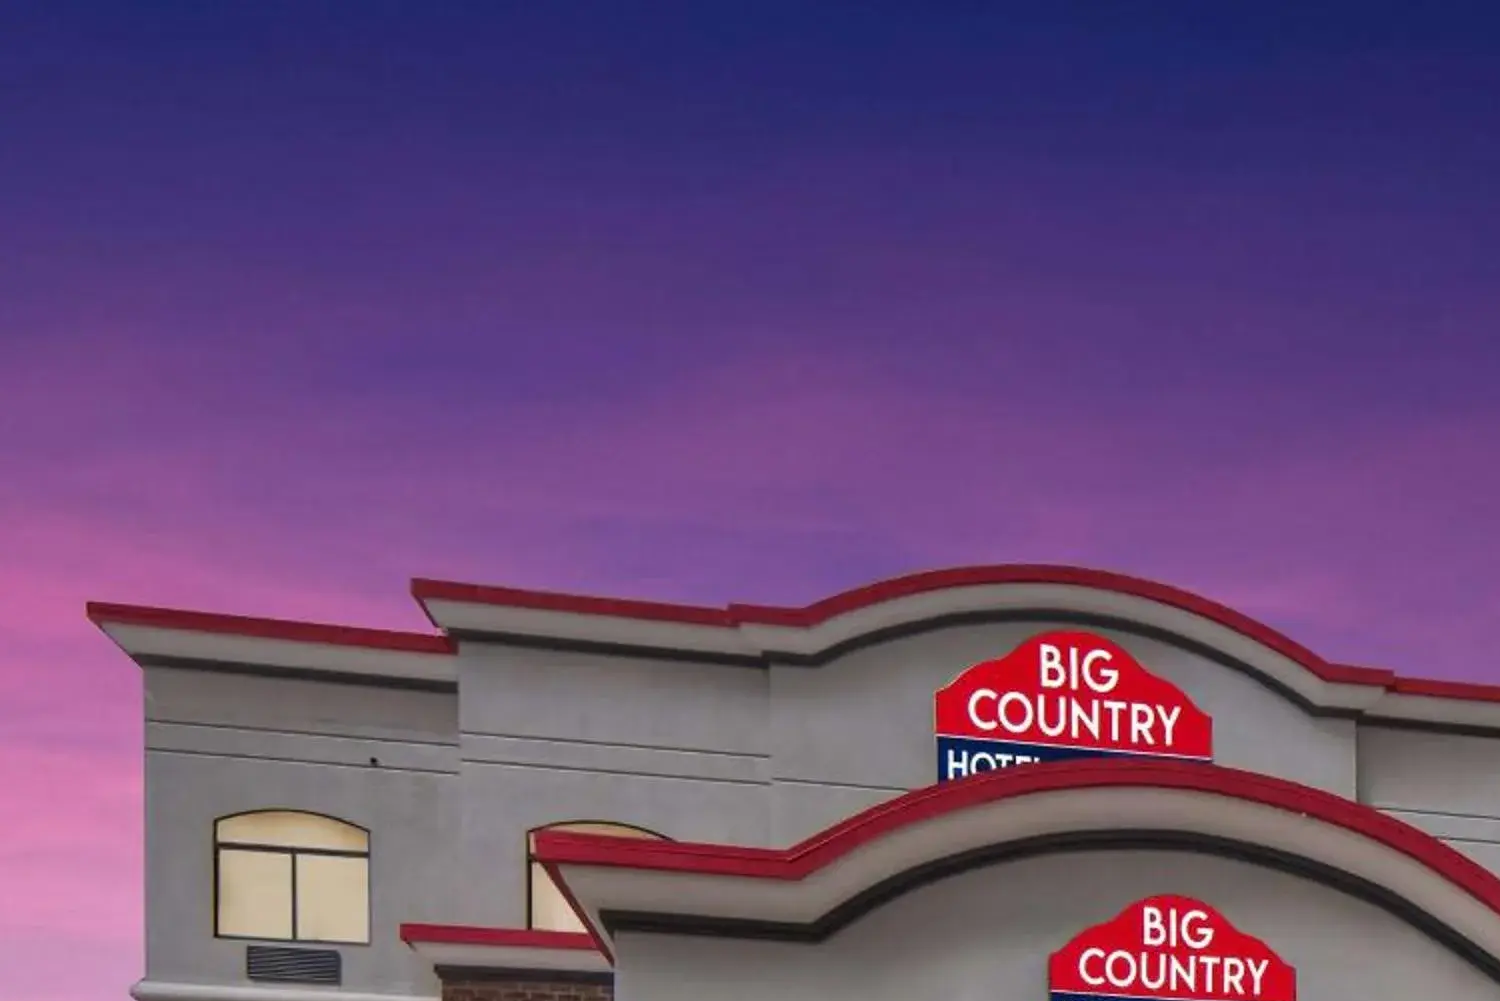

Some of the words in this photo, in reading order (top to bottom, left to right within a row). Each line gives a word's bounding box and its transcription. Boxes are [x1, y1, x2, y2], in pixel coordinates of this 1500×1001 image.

[1039, 643, 1119, 693] BIG
[967, 688, 1181, 746] COUNTRY
[1142, 905, 1214, 949] BIG
[1078, 947, 1269, 995] COUNTRY
